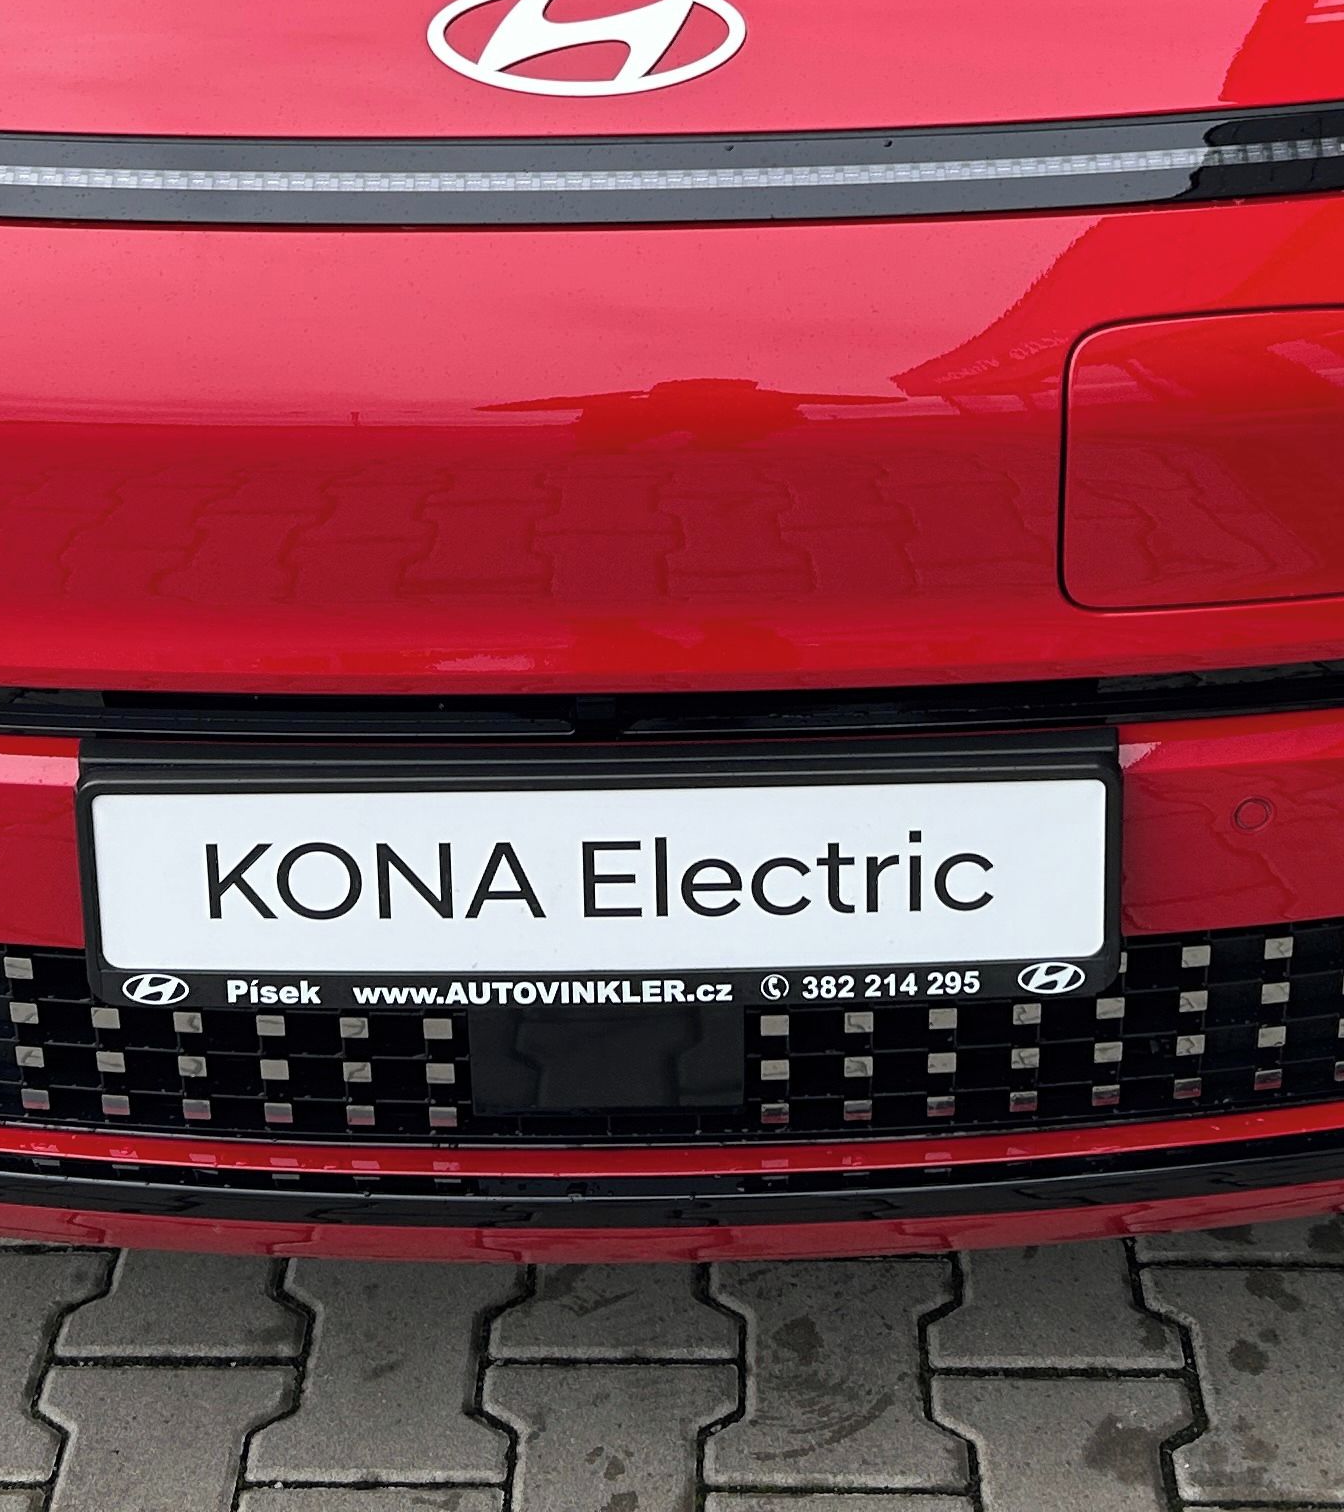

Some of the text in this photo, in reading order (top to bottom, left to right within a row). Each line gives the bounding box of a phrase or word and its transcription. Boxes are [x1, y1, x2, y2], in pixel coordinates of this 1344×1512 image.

[205, 830, 994, 921] KONA Electric
[226, 970, 981, 1005] Písek www.AUTOVINKLER.cz 382 214 295
